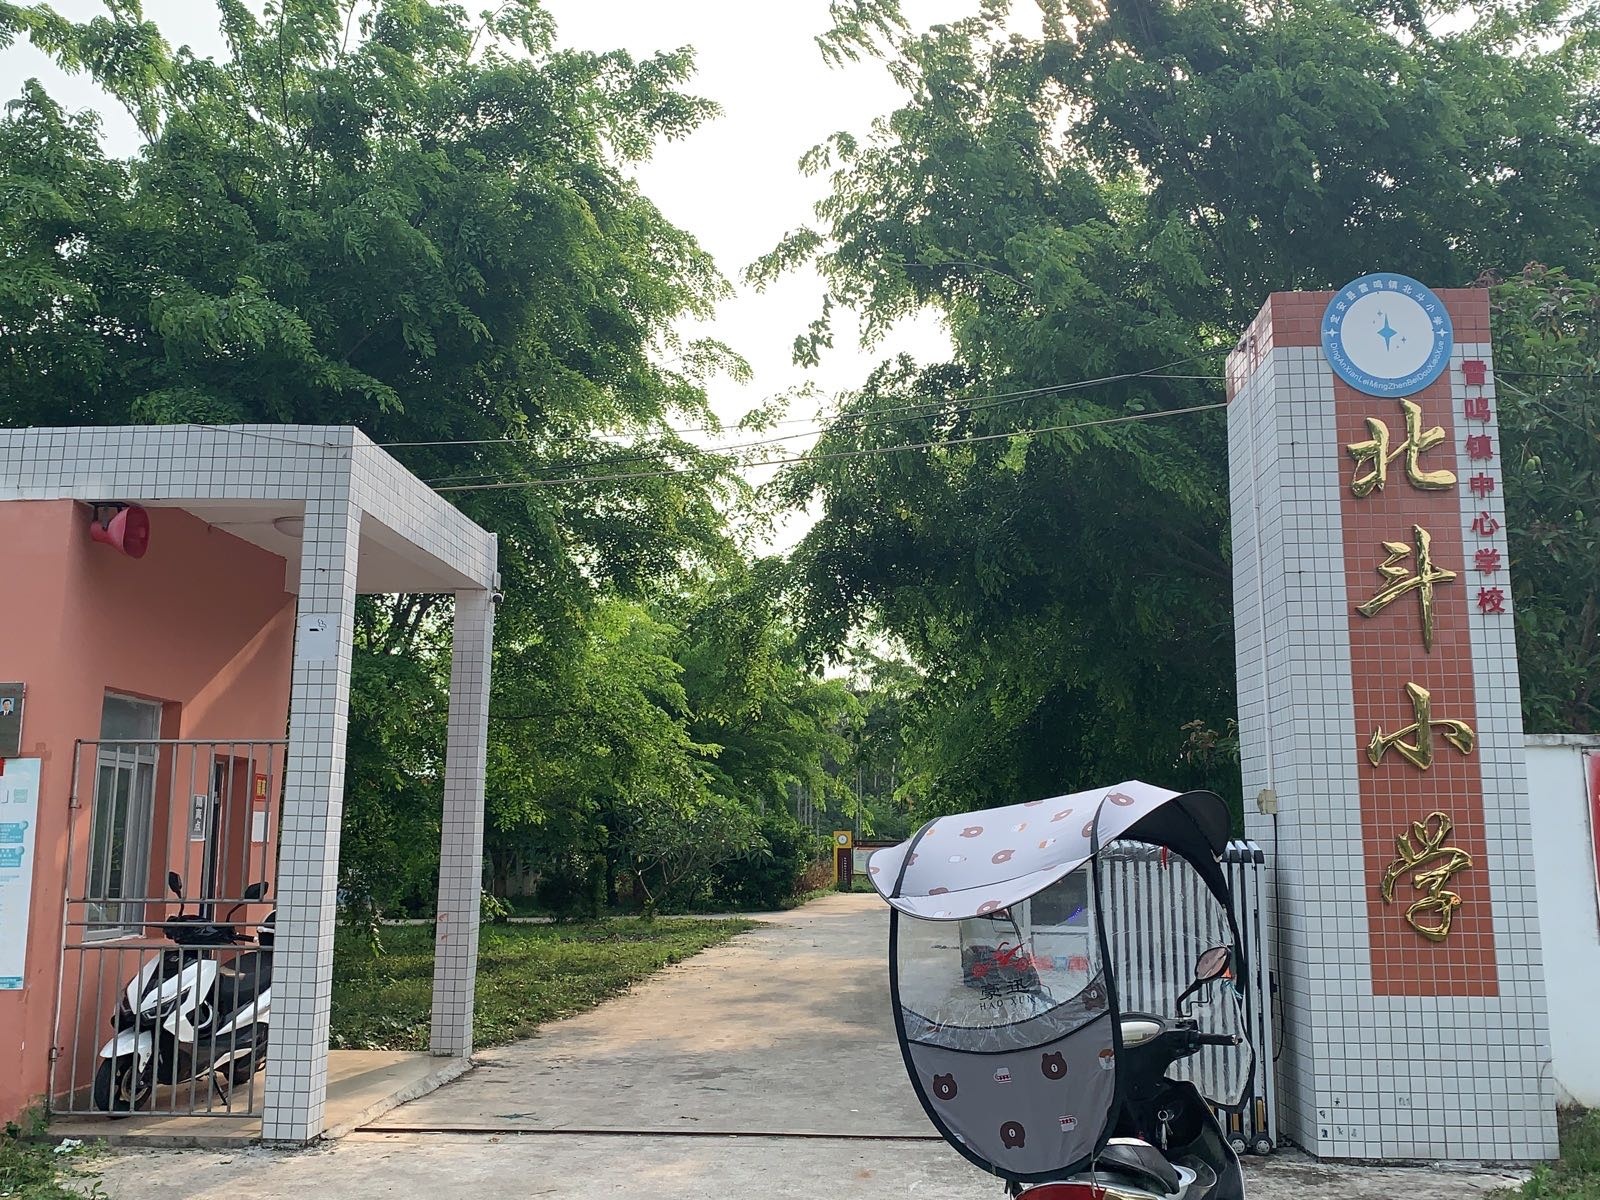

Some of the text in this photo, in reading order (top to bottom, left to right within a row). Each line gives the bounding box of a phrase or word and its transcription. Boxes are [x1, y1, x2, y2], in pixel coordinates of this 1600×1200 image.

[1462, 359, 1506, 615] 雷鸣镇中心学校
[1347, 397, 1475, 943] 北斗小学
[979, 999, 1004, 1011] HAO
[980, 978, 1030, 1001] 豪迅
